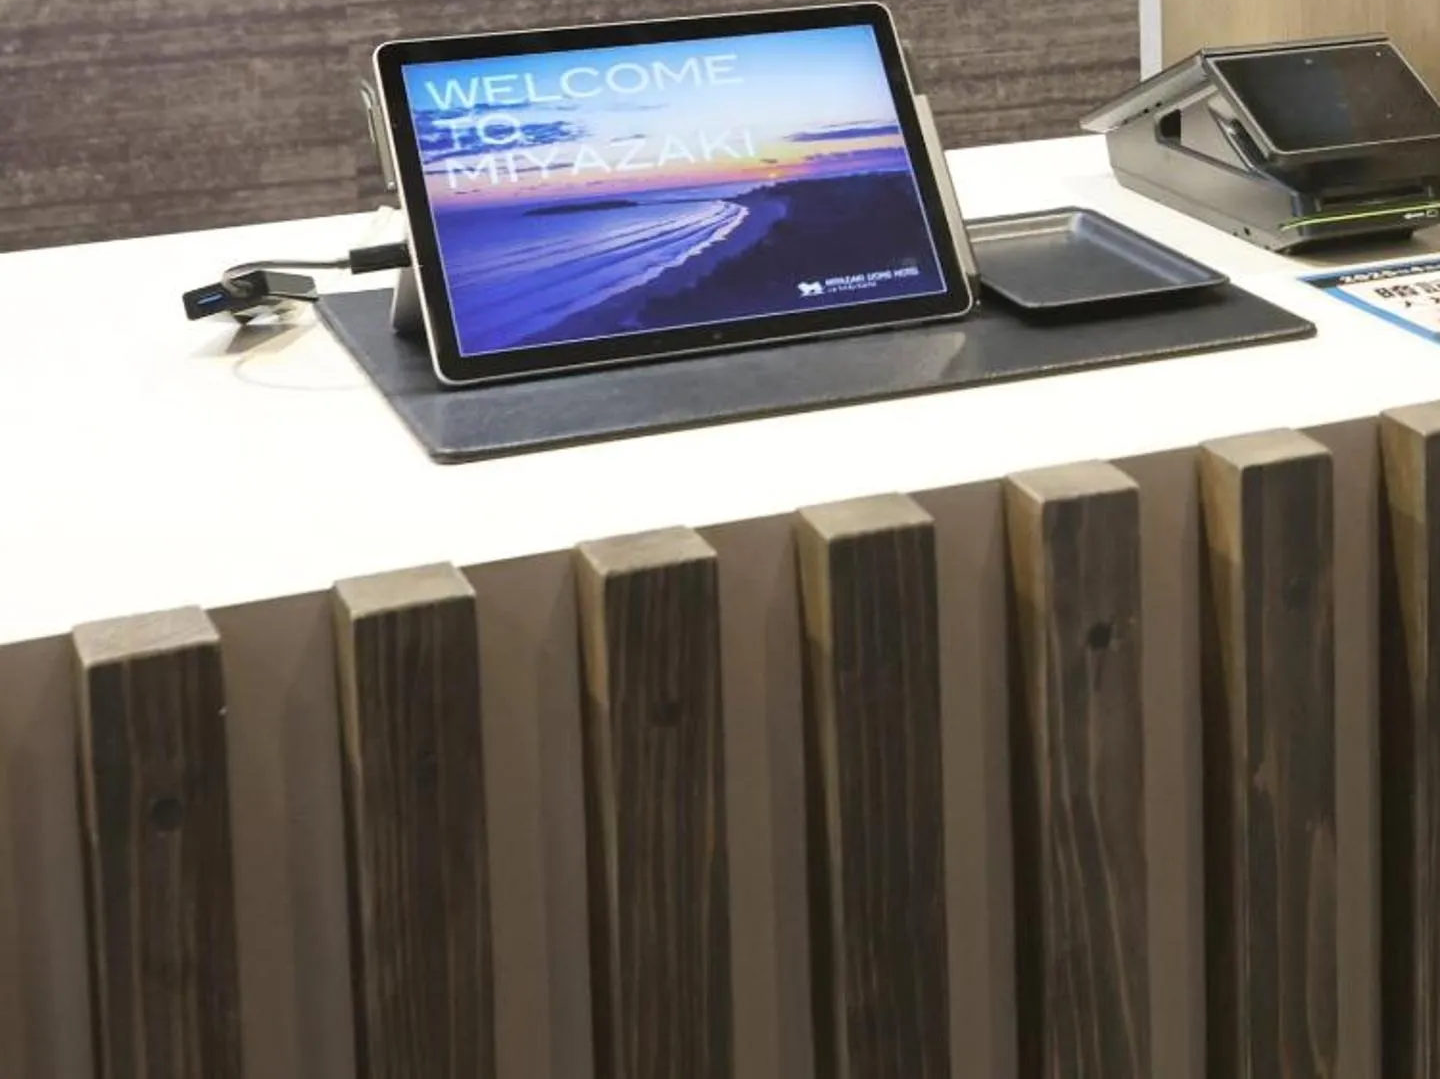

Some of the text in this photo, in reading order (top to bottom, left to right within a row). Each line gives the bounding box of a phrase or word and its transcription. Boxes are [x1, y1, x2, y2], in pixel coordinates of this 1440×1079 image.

[425, 54, 743, 110] WELCOME
[432, 111, 524, 151] TO
[444, 128, 756, 189] MIYAZAKI
